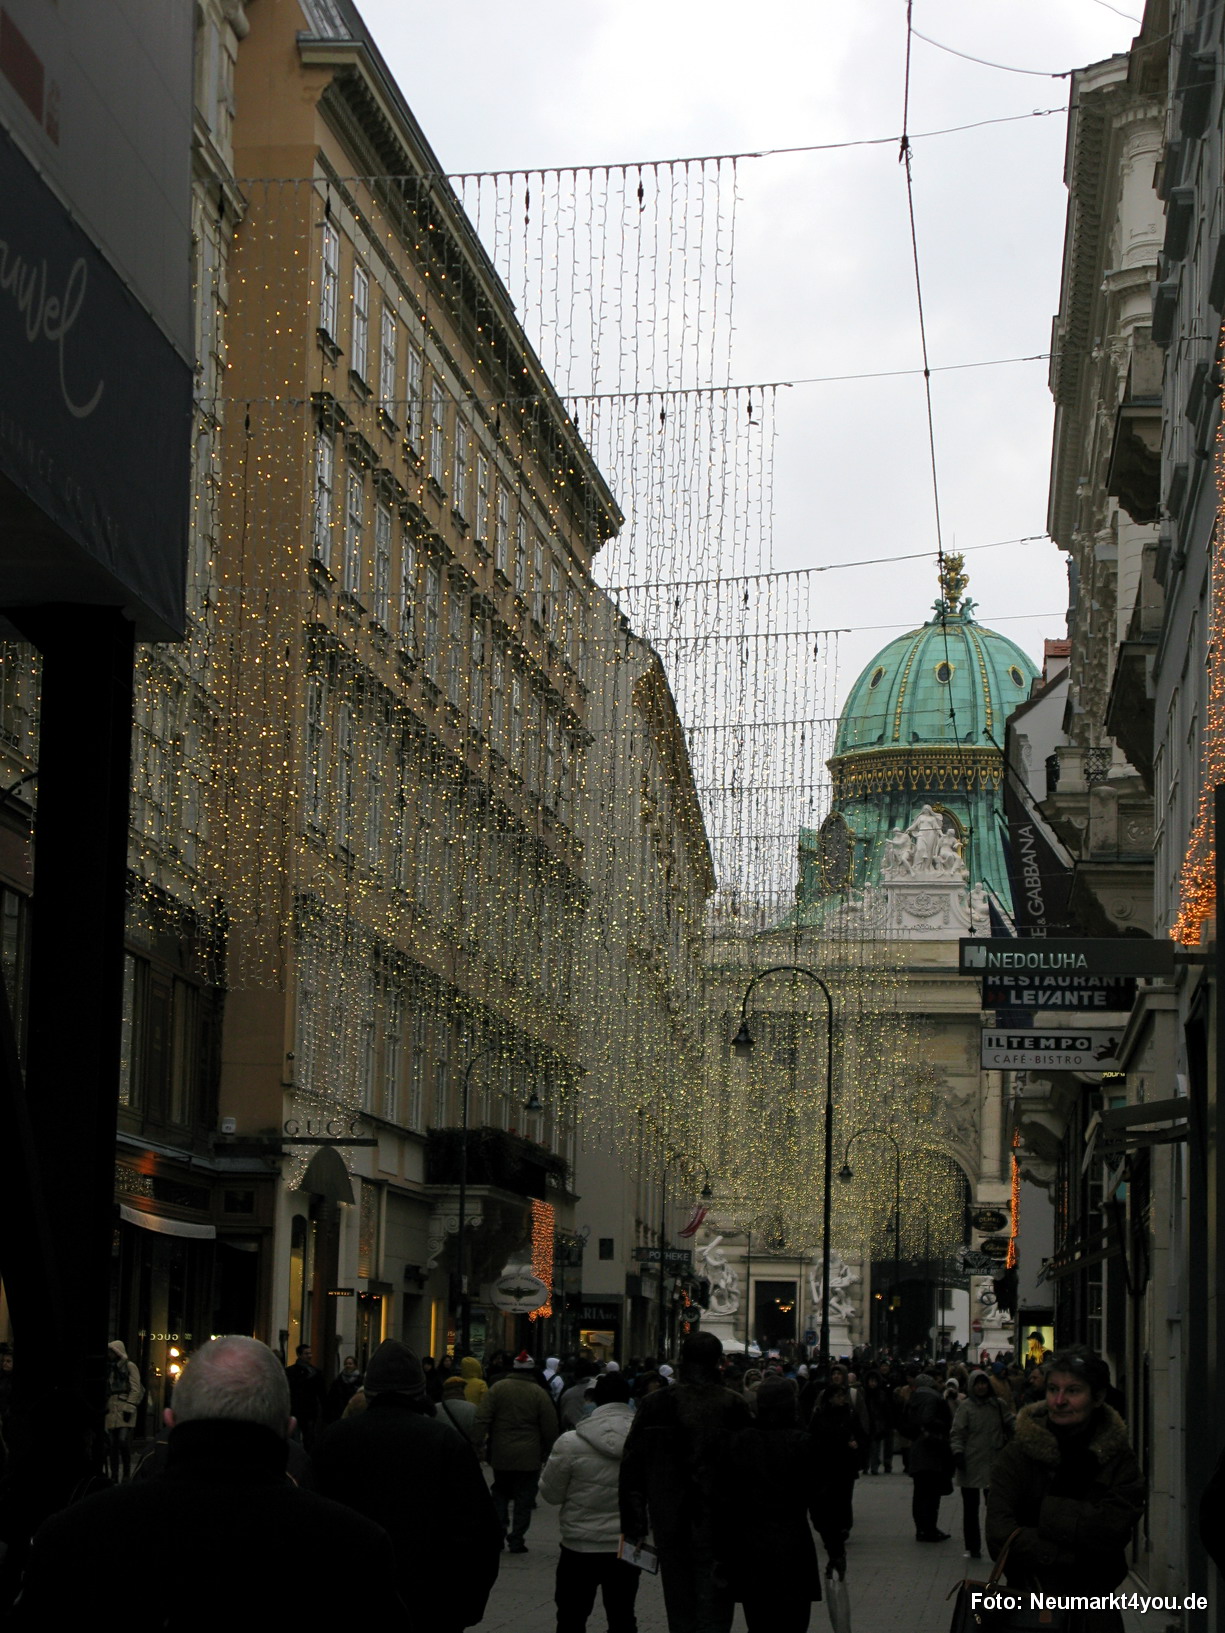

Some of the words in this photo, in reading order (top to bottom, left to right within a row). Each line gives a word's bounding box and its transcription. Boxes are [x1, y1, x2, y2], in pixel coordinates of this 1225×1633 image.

[1018, 825, 1046, 916] GABBANA
[988, 953, 1088, 969] NEDOLUHA
[987, 975, 1127, 987] RESTAURANT
[1010, 990, 1107, 1006] LEVANTE
[1008, 1037, 1090, 1049] TEMPO
